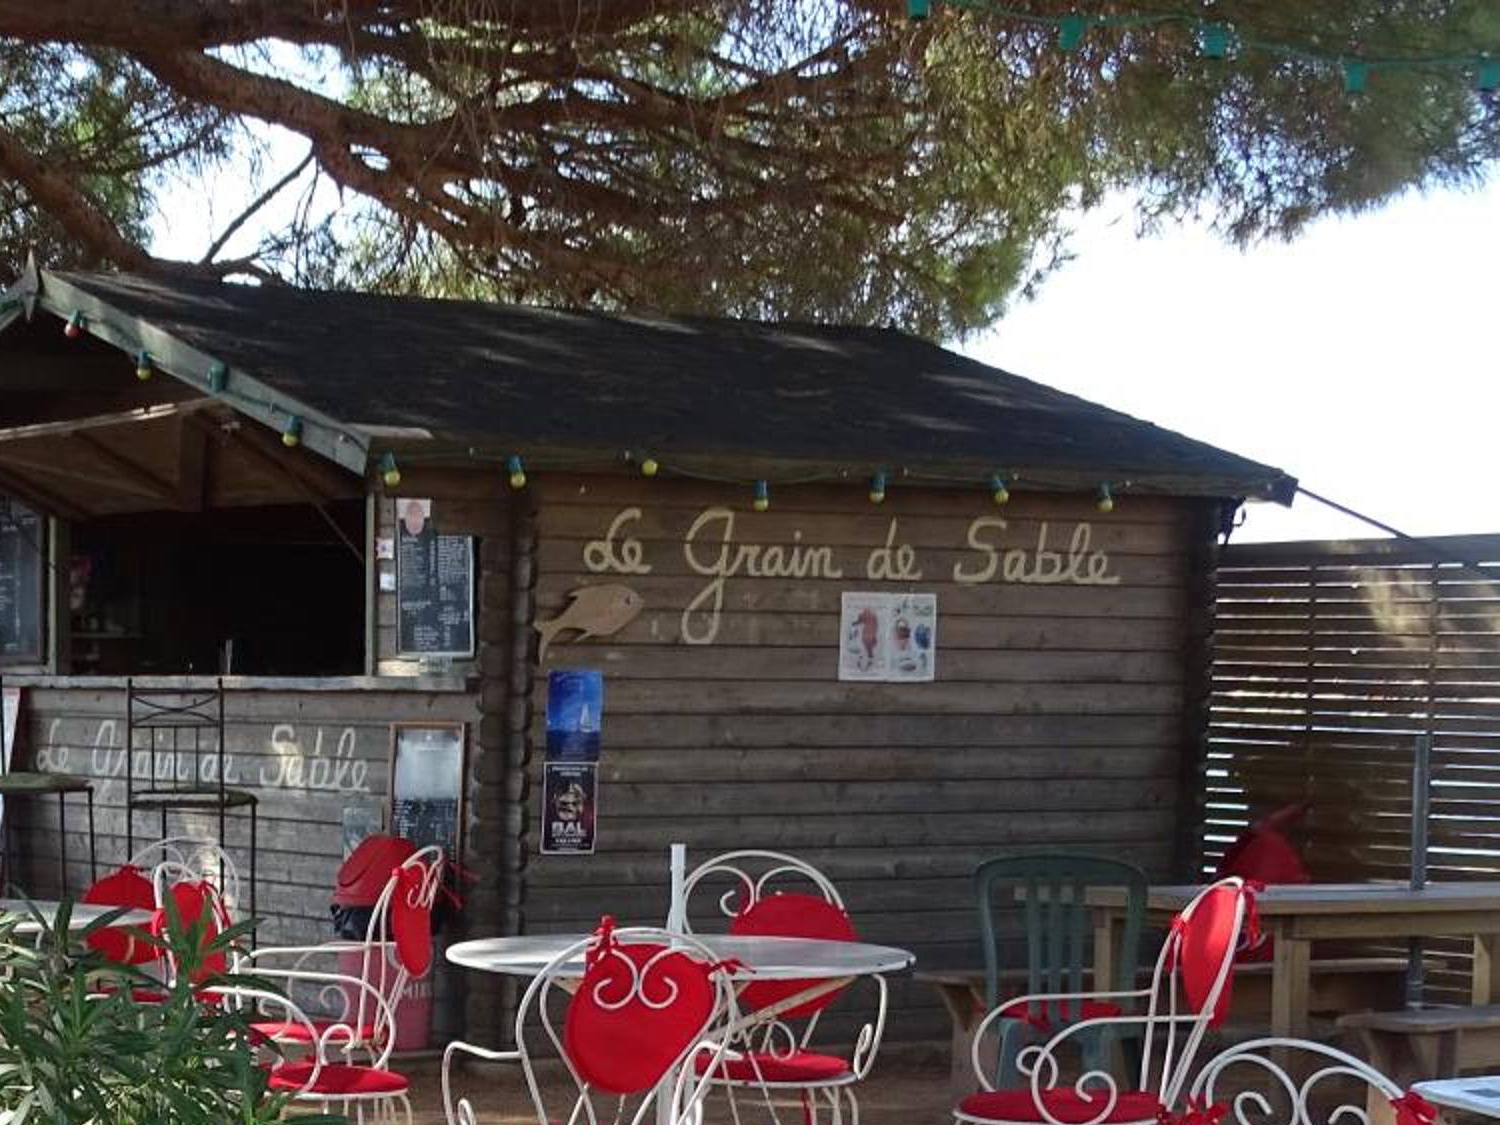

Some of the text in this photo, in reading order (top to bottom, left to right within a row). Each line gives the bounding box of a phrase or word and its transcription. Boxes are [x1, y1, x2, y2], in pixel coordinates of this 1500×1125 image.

[583, 506, 1120, 645] Le Grain de Sable
[35, 718, 370, 801] Le Grain de Sable
